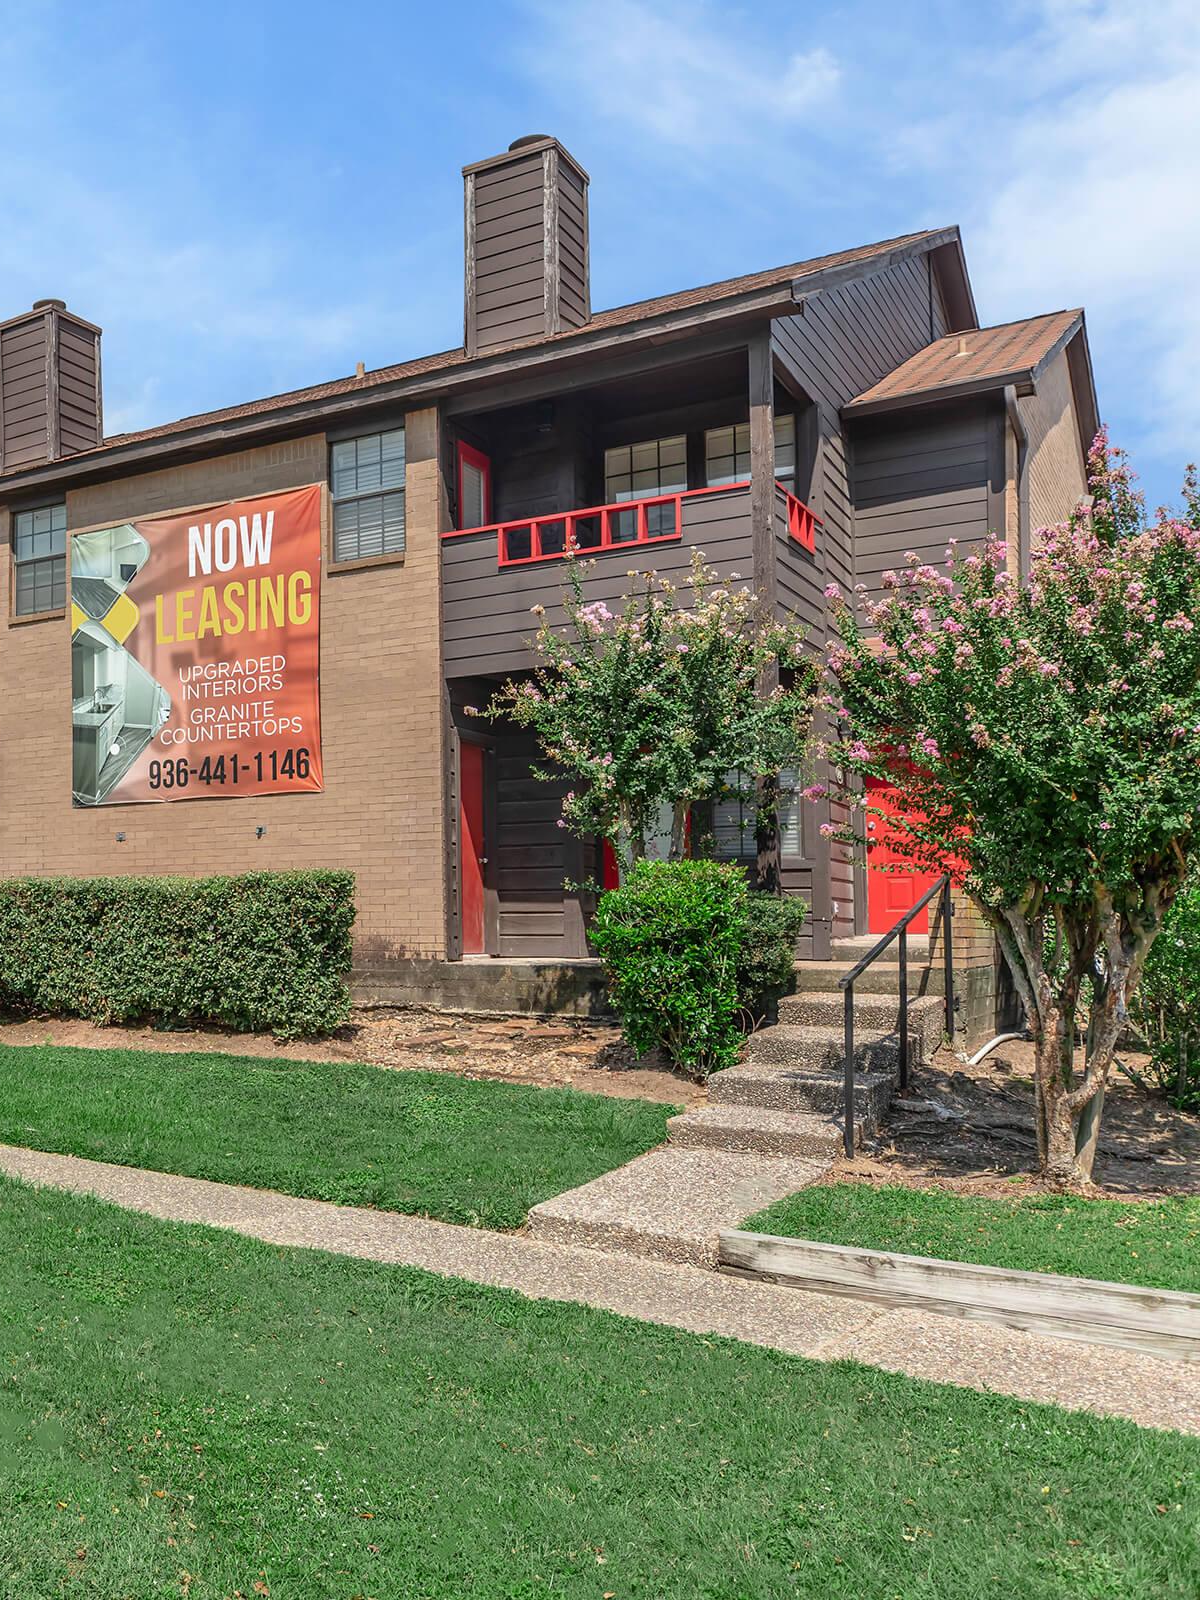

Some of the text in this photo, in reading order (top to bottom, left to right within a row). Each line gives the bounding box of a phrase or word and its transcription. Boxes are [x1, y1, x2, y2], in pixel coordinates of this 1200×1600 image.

[188, 511, 275, 577] NOW
[155, 570, 312, 645] LEASING
[179, 655, 286, 683] UPGRADED
[182, 674, 283, 701] INTERIORS
[190, 700, 274, 725] GRANITE
[160, 716, 303, 746] COUNTERTOPS
[149, 748, 310, 790] 936-441-1146
